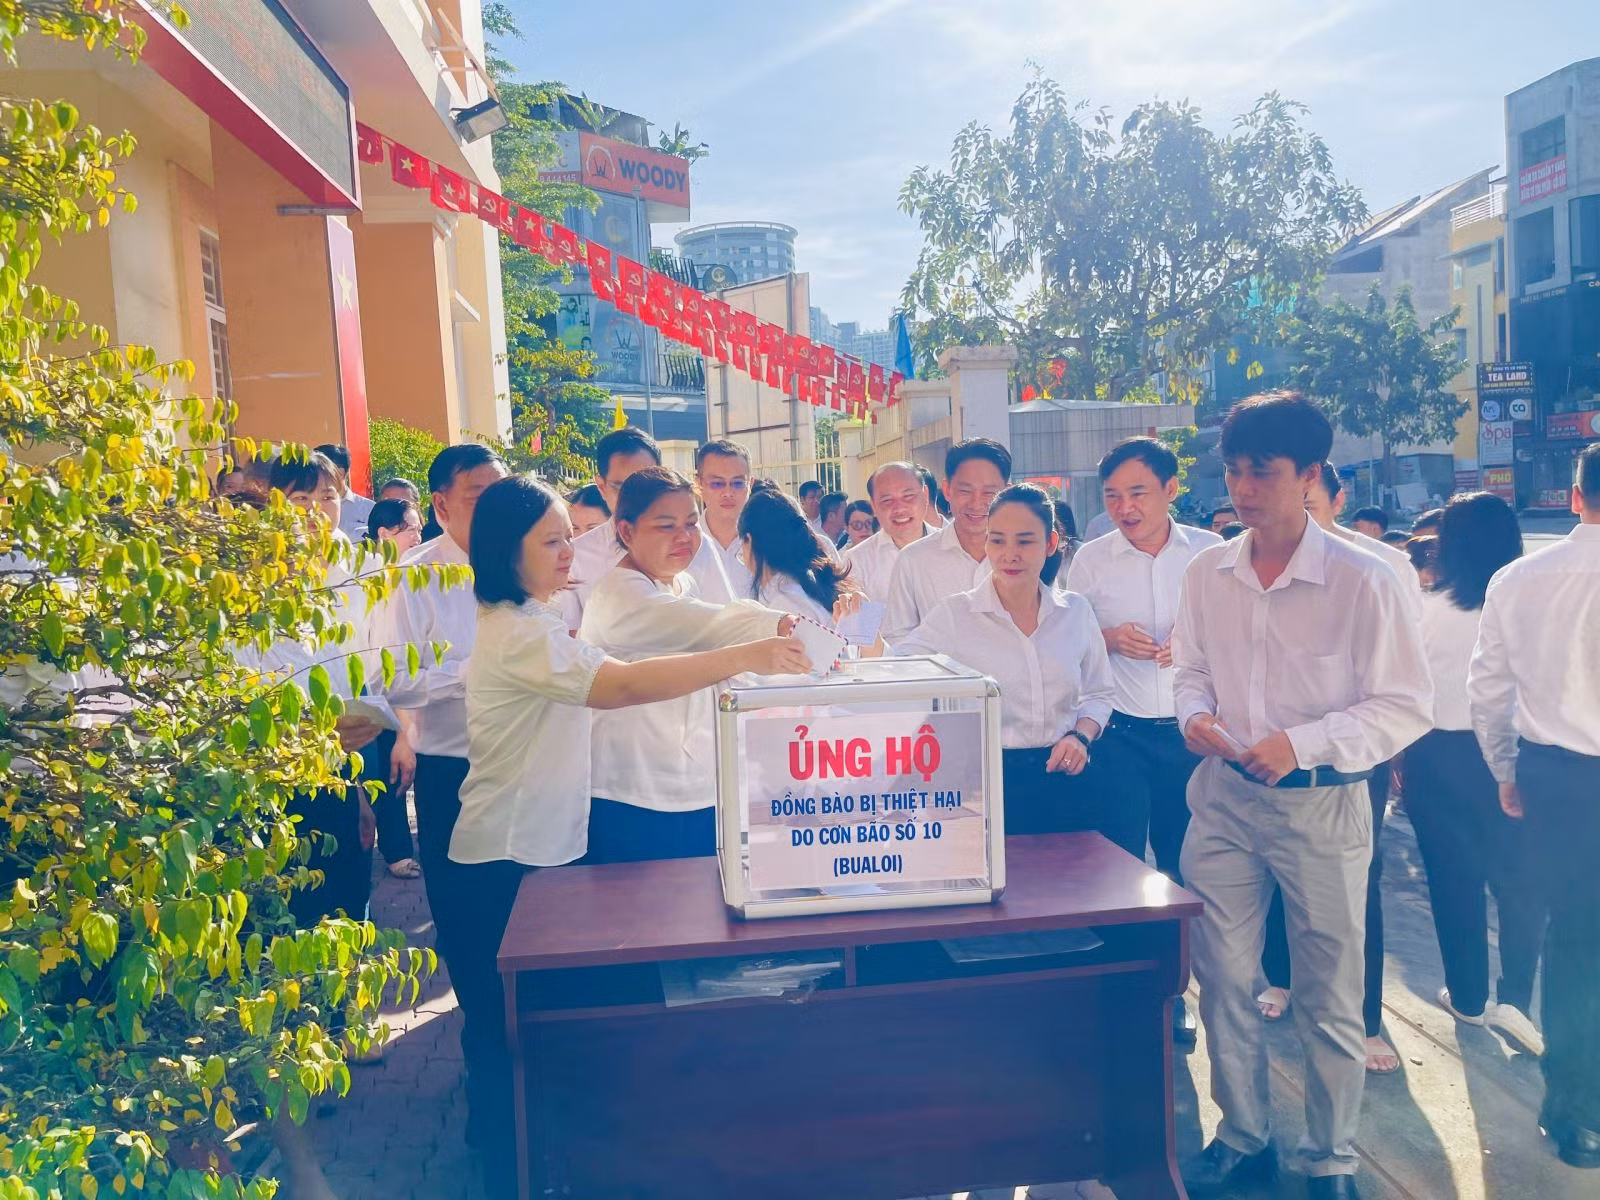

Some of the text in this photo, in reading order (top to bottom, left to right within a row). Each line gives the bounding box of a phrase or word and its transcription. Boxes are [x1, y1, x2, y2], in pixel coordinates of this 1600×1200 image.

[618, 157, 686, 192] WOODY
[611, 351, 639, 360] WOODY
[1488, 371, 1527, 382] TEA LAND
[1483, 423, 1512, 446] Spa
[789, 724, 941, 782] ỦNG HỘ
[771, 788, 961, 817] ĐỒNG BÀO BỊ THIỆT HẠI
[792, 815, 942, 846] DO CƠN BÃO SỐ 10
[833, 855, 903, 877] (BUALOI)
